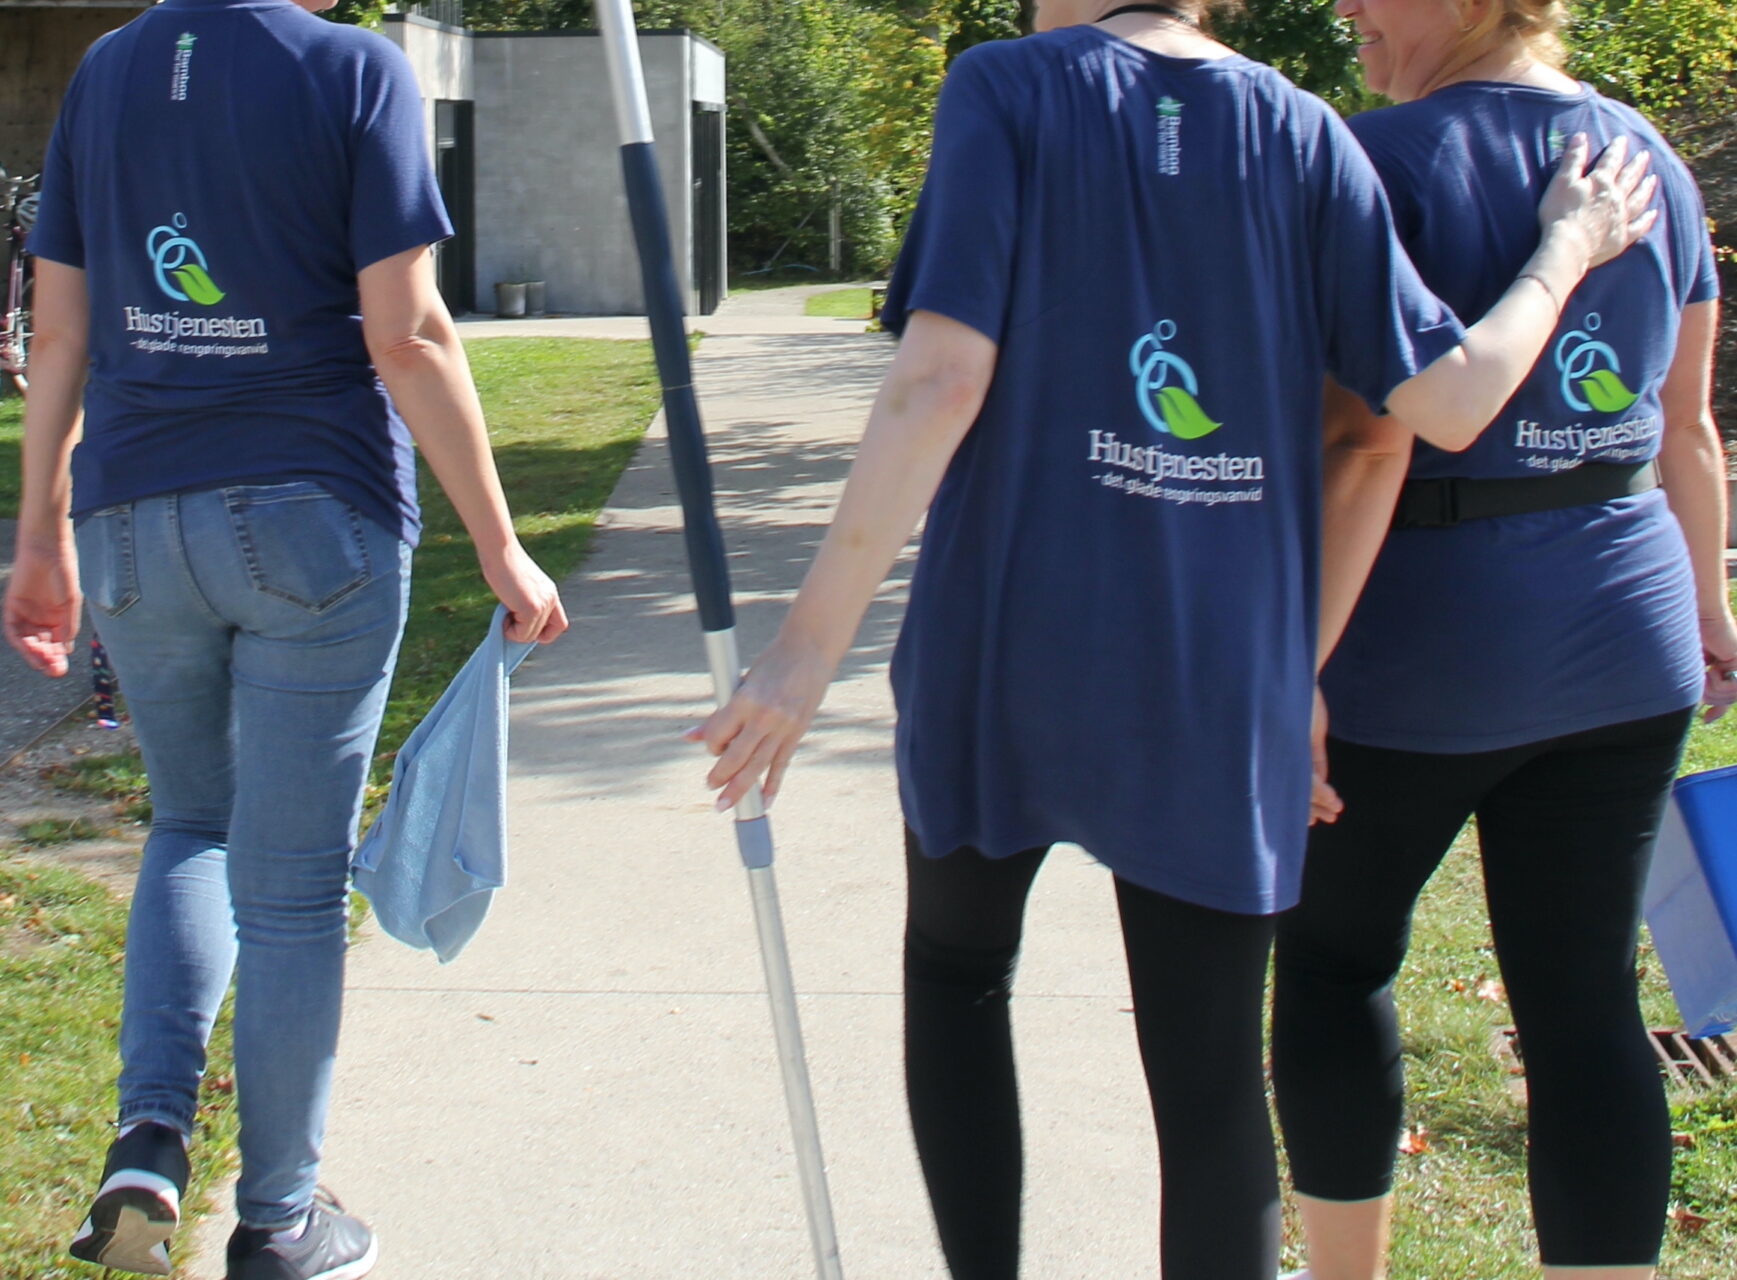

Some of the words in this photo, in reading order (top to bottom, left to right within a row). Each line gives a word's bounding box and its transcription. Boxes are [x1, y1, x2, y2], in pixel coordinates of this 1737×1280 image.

[178, 48, 193, 101] Bamboo
[1167, 116, 1182, 176] Bamboo
[123, 306, 268, 339] Hustjenesten
[1087, 429, 1265, 482] Hustjenesten
[1124, 477, 1163, 498] glade
